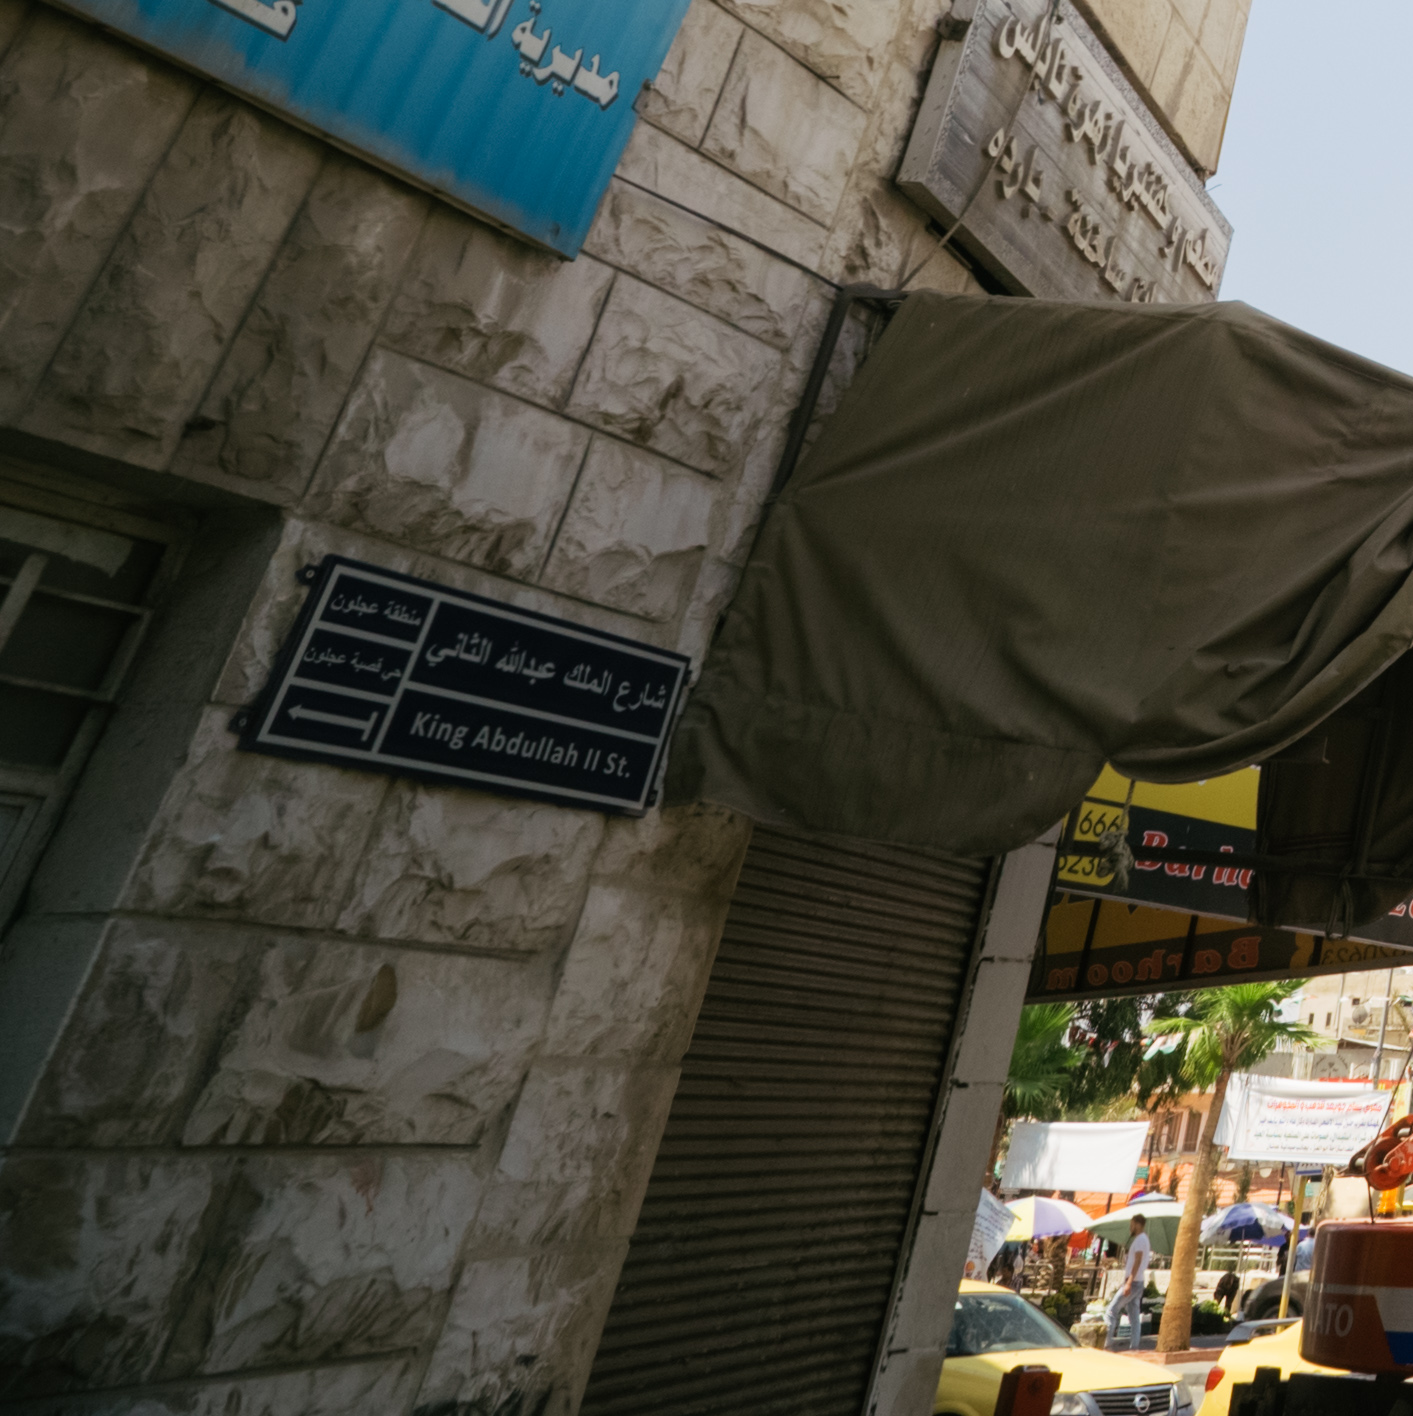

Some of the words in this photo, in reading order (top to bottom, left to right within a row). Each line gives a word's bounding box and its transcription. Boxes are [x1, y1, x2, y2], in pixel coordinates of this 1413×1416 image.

[330, 591, 379, 618] عجلون
[383, 599, 421, 627] منطقة
[303, 645, 346, 667] عجلون
[425, 632, 492, 667] الثاني
[381, 666, 402, 681] حي
[563, 662, 611, 697] الملك
[612, 680, 666, 712] شارع
[410, 711, 469, 750] King
[471, 725, 578, 768] Abdullah
[602, 751, 631, 779] St.
